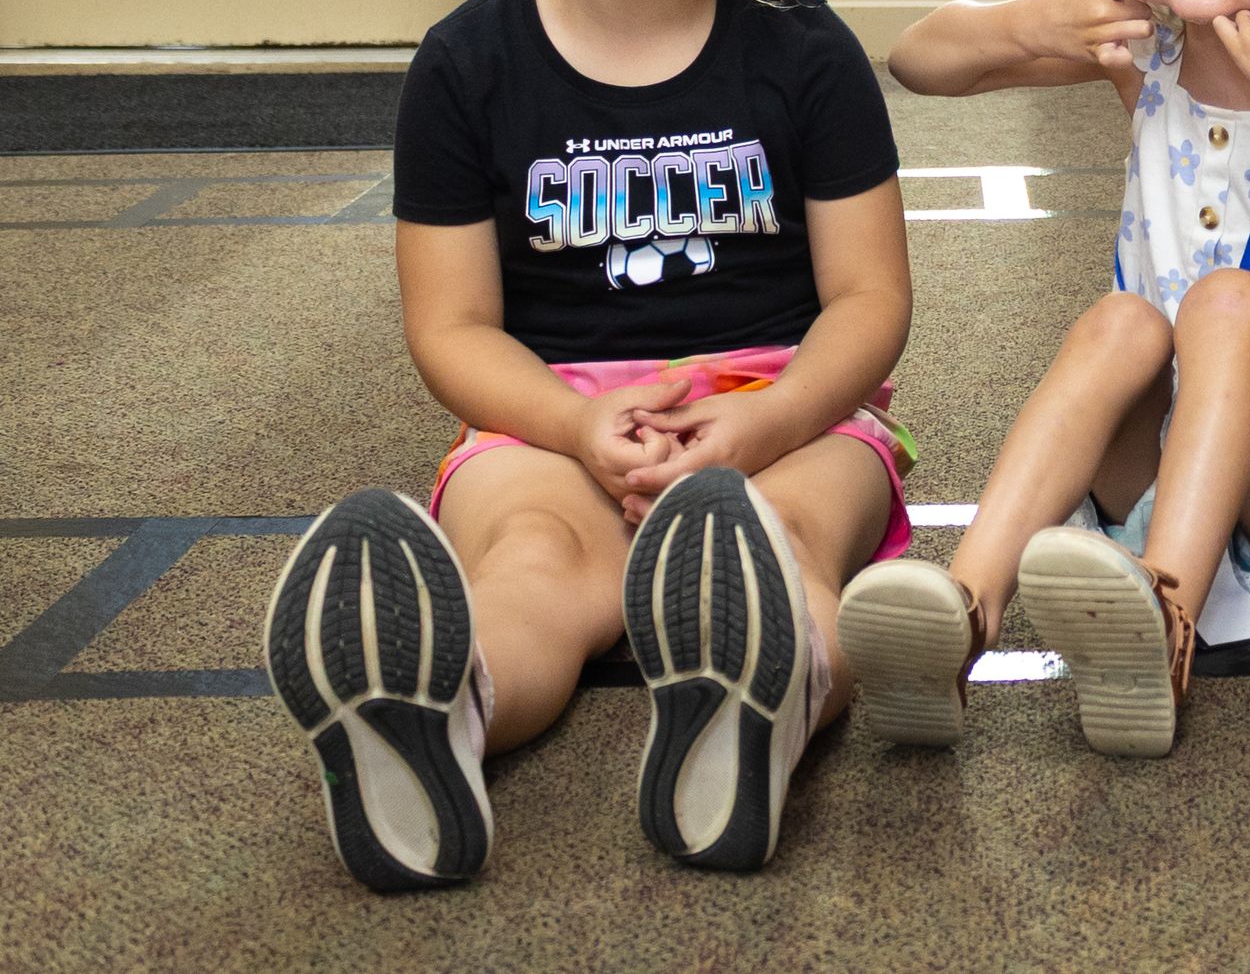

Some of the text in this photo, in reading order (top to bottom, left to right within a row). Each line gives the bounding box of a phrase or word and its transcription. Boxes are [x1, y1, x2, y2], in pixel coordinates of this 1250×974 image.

[594, 128, 734, 152] UNDER ARMOUR
[525, 139, 780, 253] SOCCER
